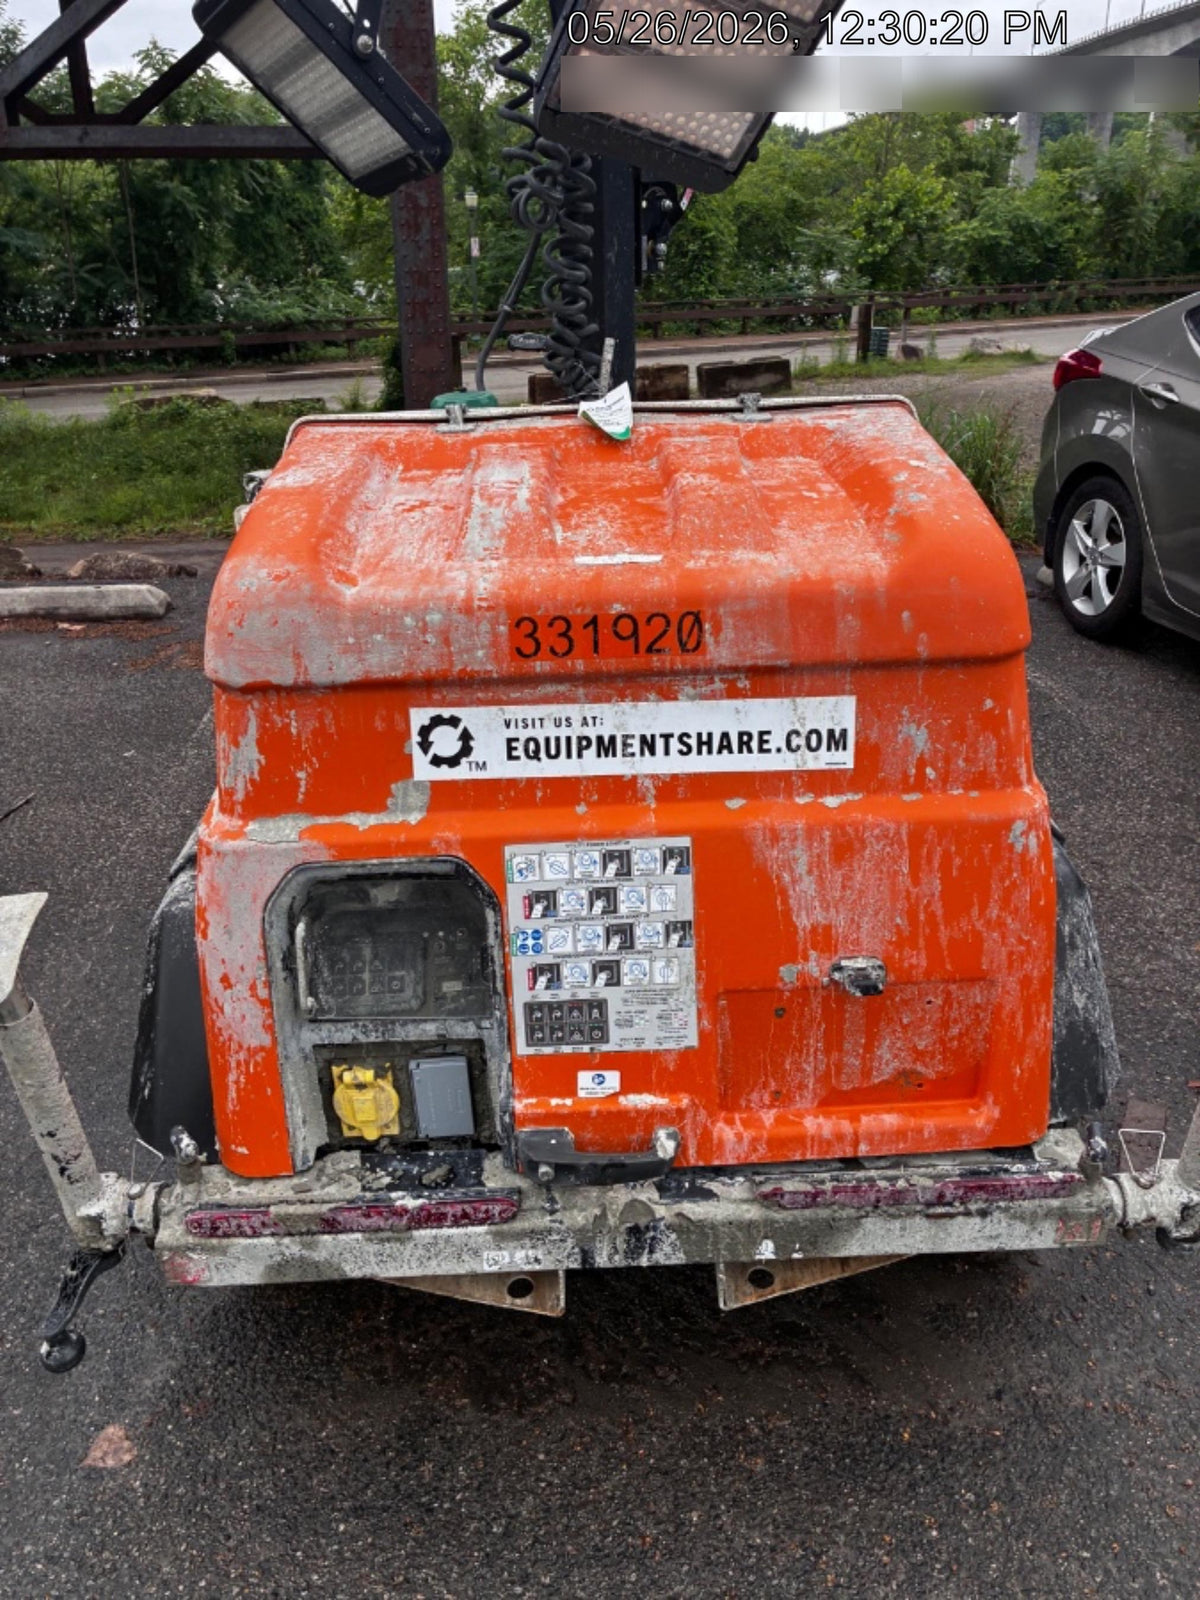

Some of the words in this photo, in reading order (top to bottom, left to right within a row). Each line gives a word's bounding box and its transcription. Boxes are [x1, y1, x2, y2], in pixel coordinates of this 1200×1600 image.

[514, 611, 703, 659] 331920
[504, 717, 545, 730] VISIT
[554, 716, 573, 728] US
[580, 715, 604, 728] AT:
[505, 727, 849, 762] EQUIPMENTSHARE.COM
[467, 760, 488, 772] TM
